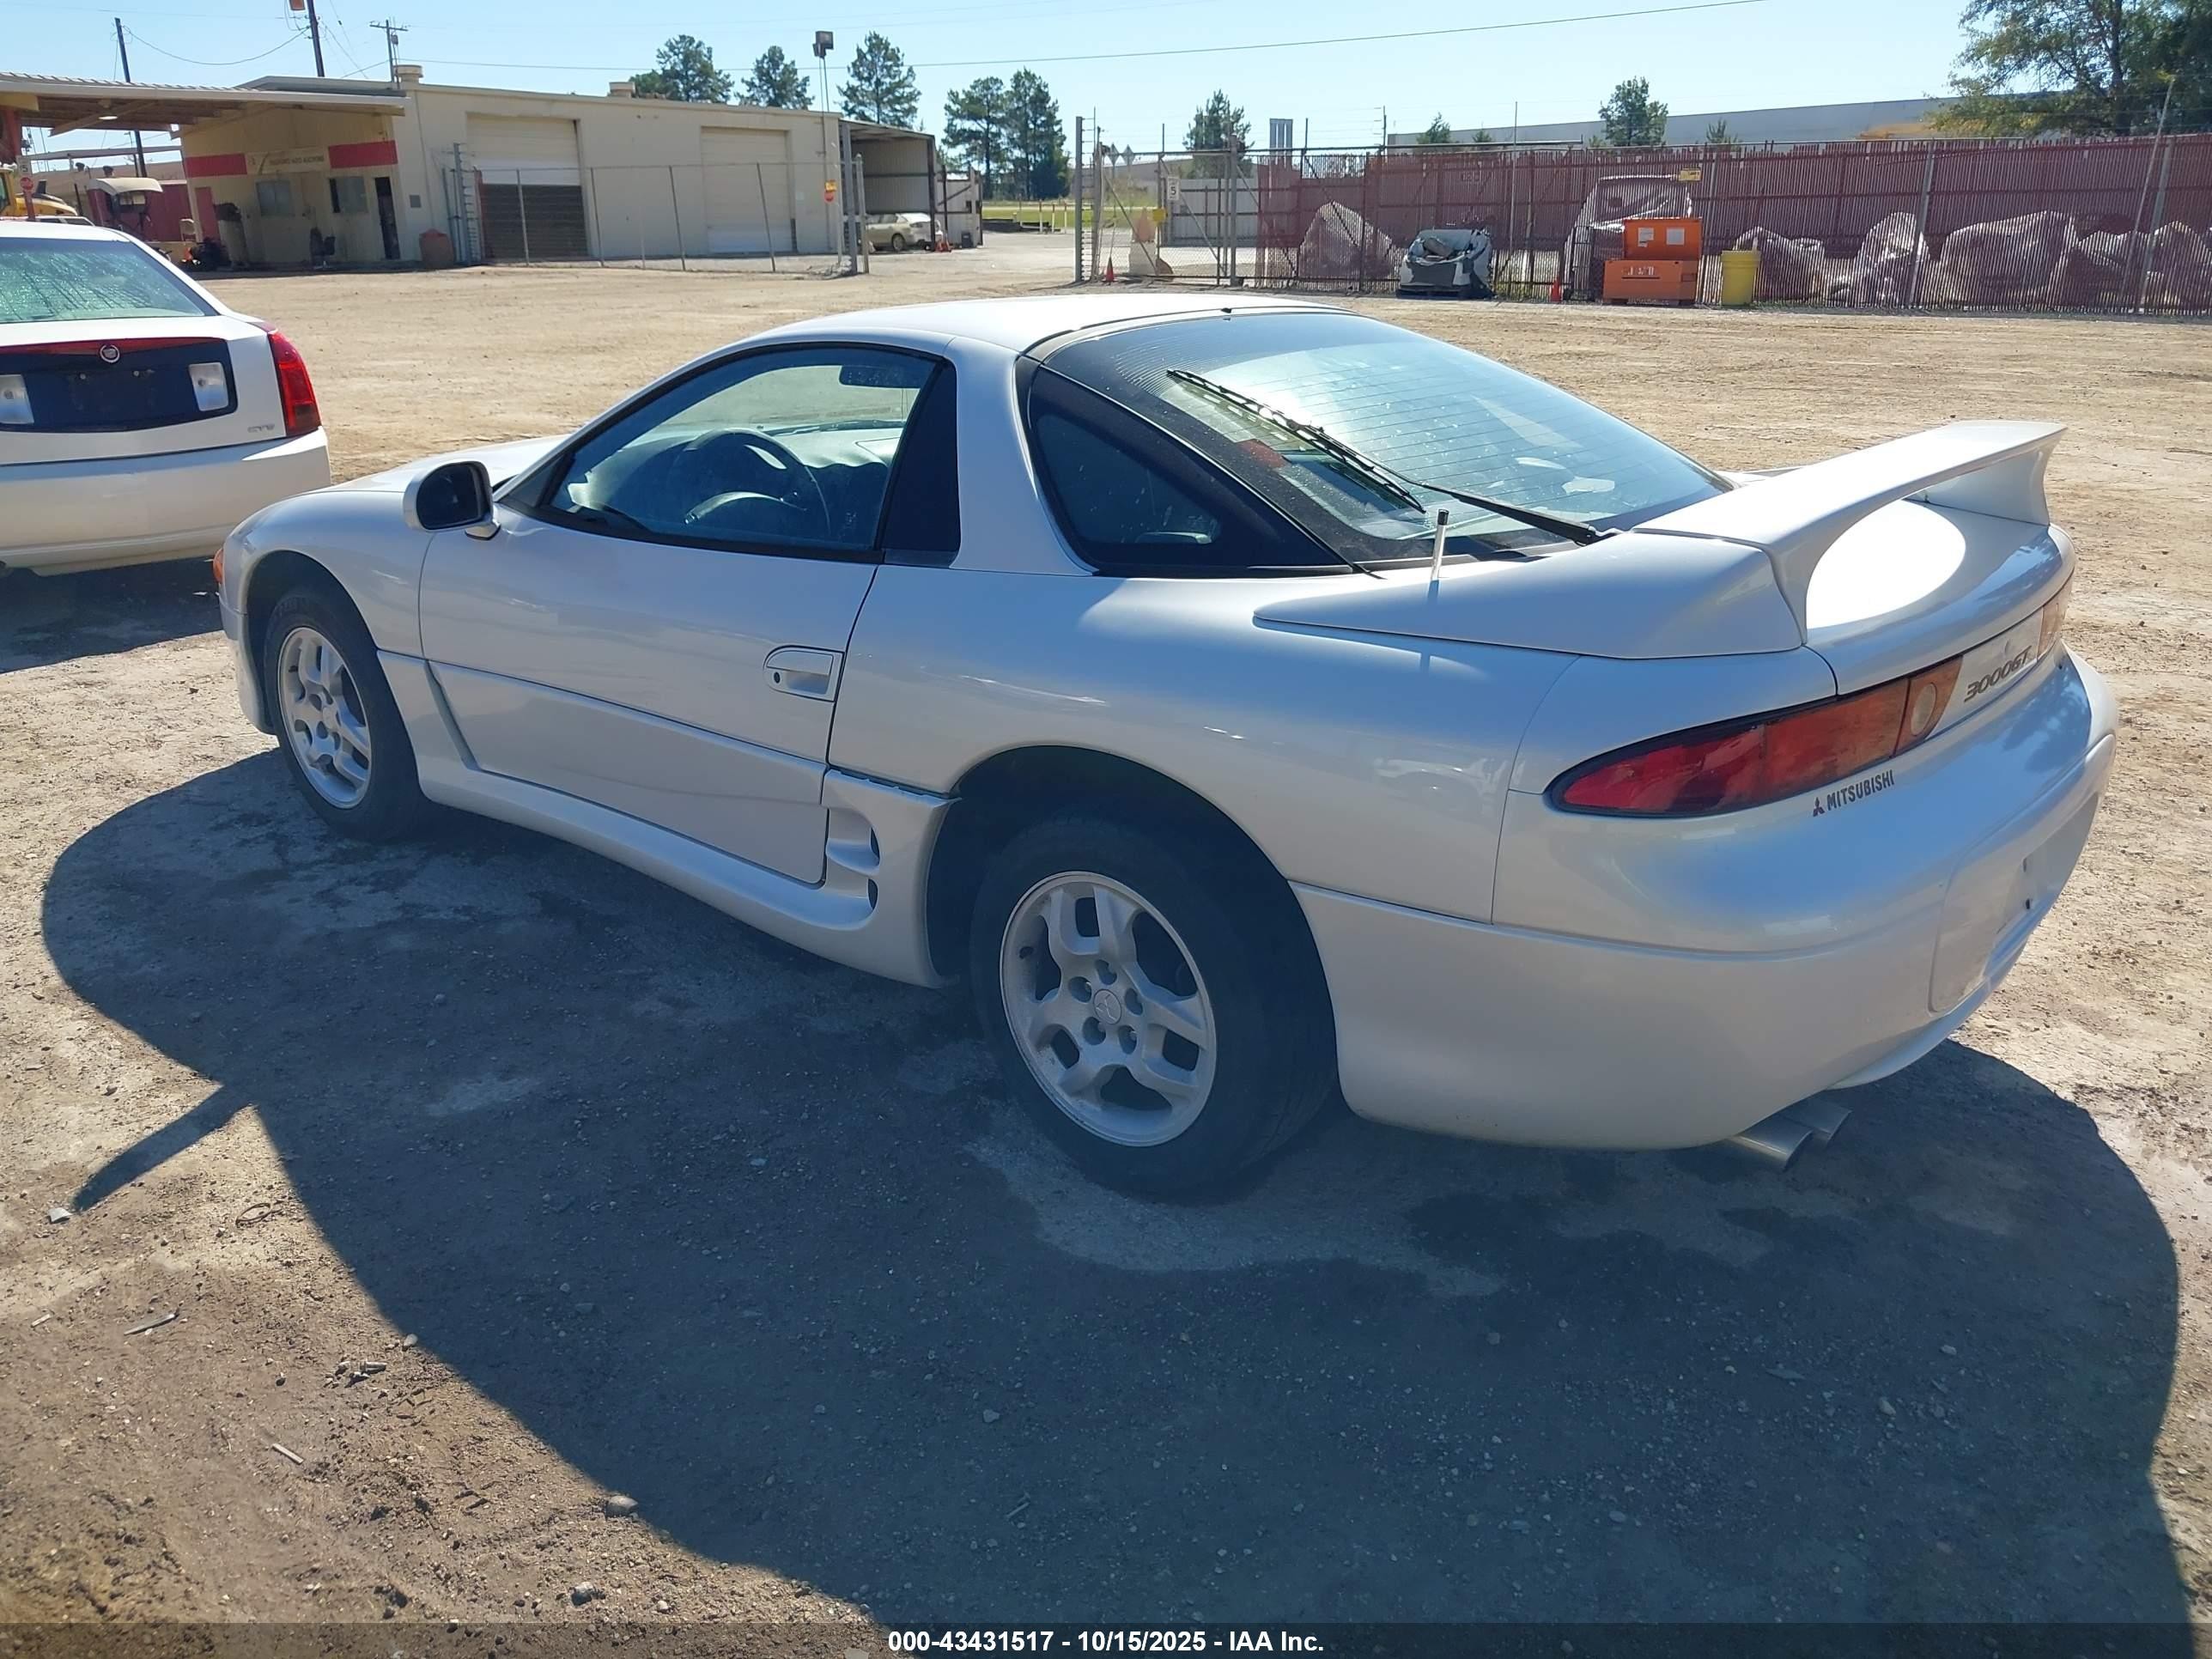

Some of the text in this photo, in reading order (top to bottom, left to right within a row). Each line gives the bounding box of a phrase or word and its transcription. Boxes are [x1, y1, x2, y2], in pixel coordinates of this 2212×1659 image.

[1170, 186, 1176, 196] 5
[1964, 645, 2032, 702] 3000GT
[1826, 769, 1894, 811] MITSUBISHI
